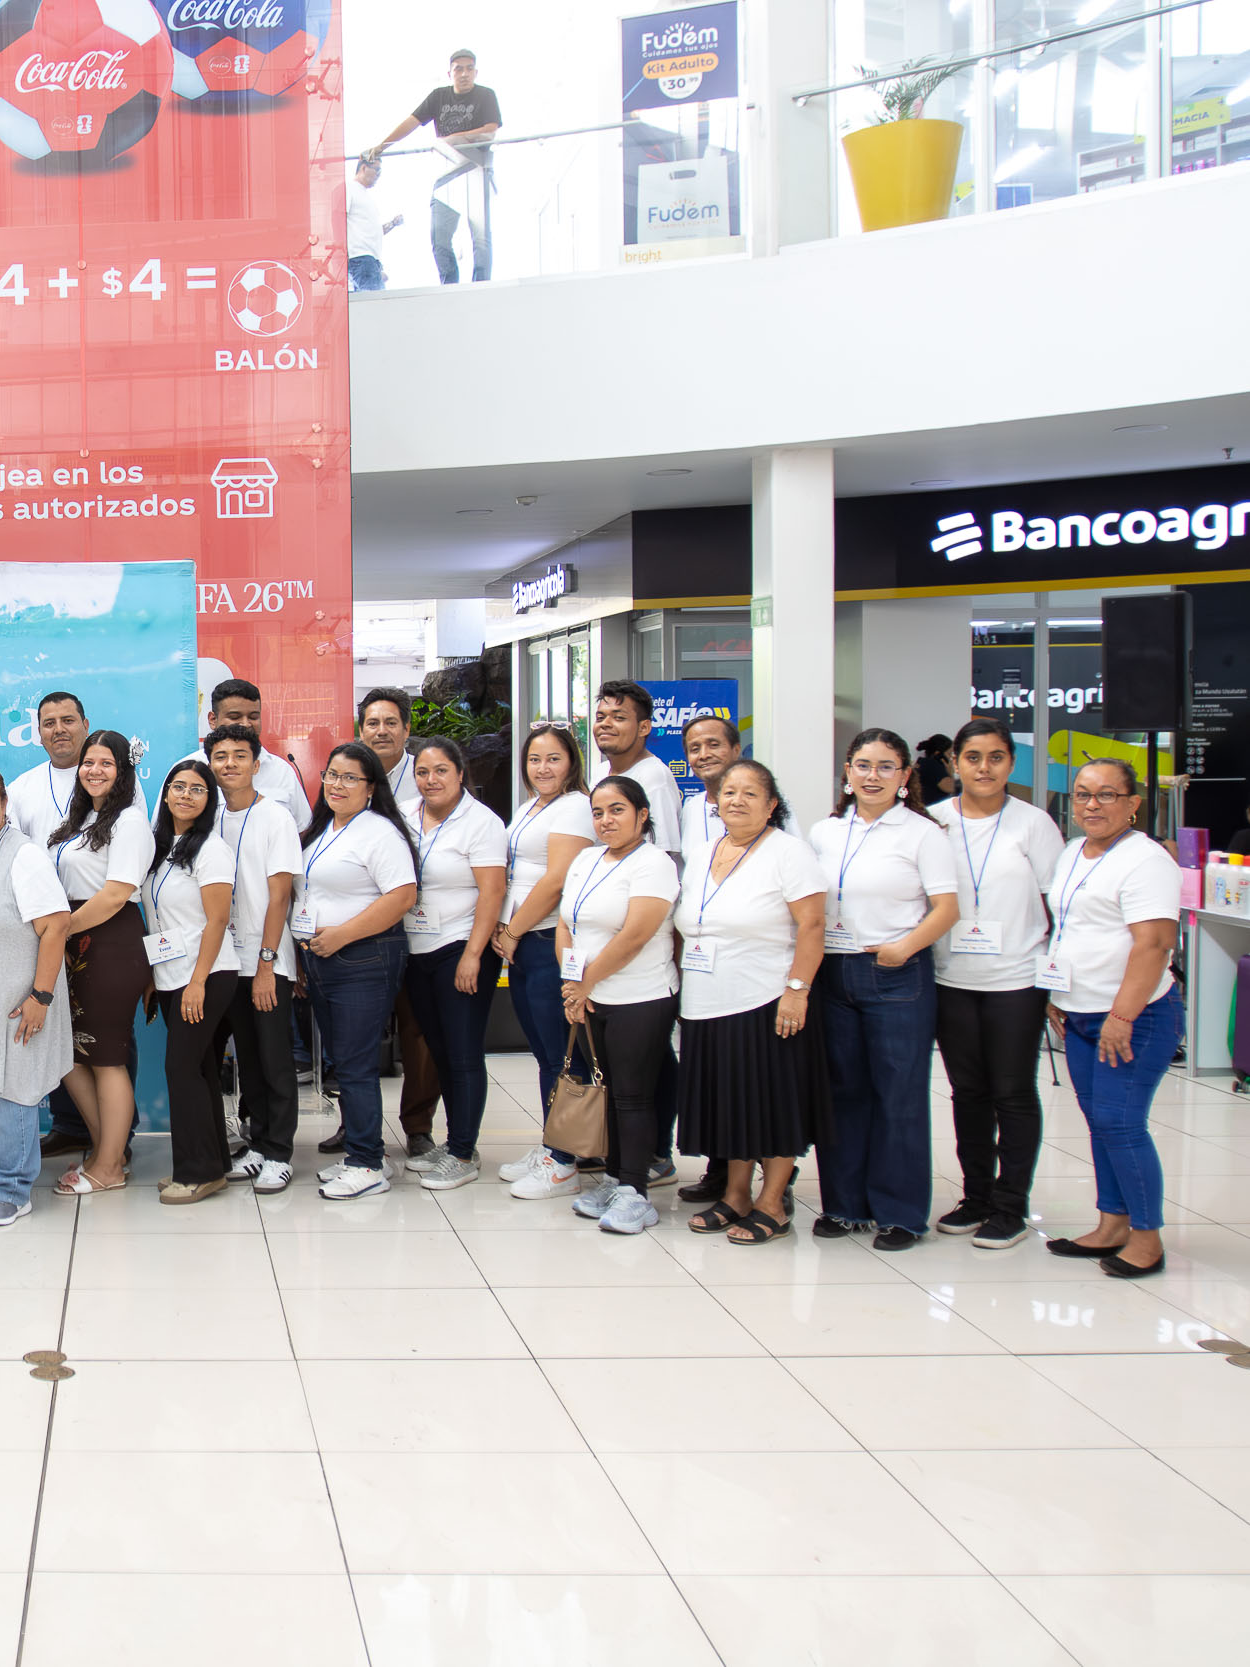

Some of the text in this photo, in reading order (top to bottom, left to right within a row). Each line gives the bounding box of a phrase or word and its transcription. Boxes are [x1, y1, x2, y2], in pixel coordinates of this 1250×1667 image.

[641, 25, 718, 52] Fudem
[642, 49, 682, 58] Cuidamos
[700, 42, 718, 50] ojos
[15, 50, 130, 93] Coca-Cola
[647, 57, 714, 74] Kit Adulto
[648, 203, 719, 223] Fudem
[215, 343, 318, 371] BALÓN
[53, 467, 89, 486] en
[100, 461, 144, 484] los
[13, 491, 196, 520] autorizados
[991, 501, 1250, 553] Bancoagr
[196, 583, 238, 613] FA
[666, 696, 675, 706] al
